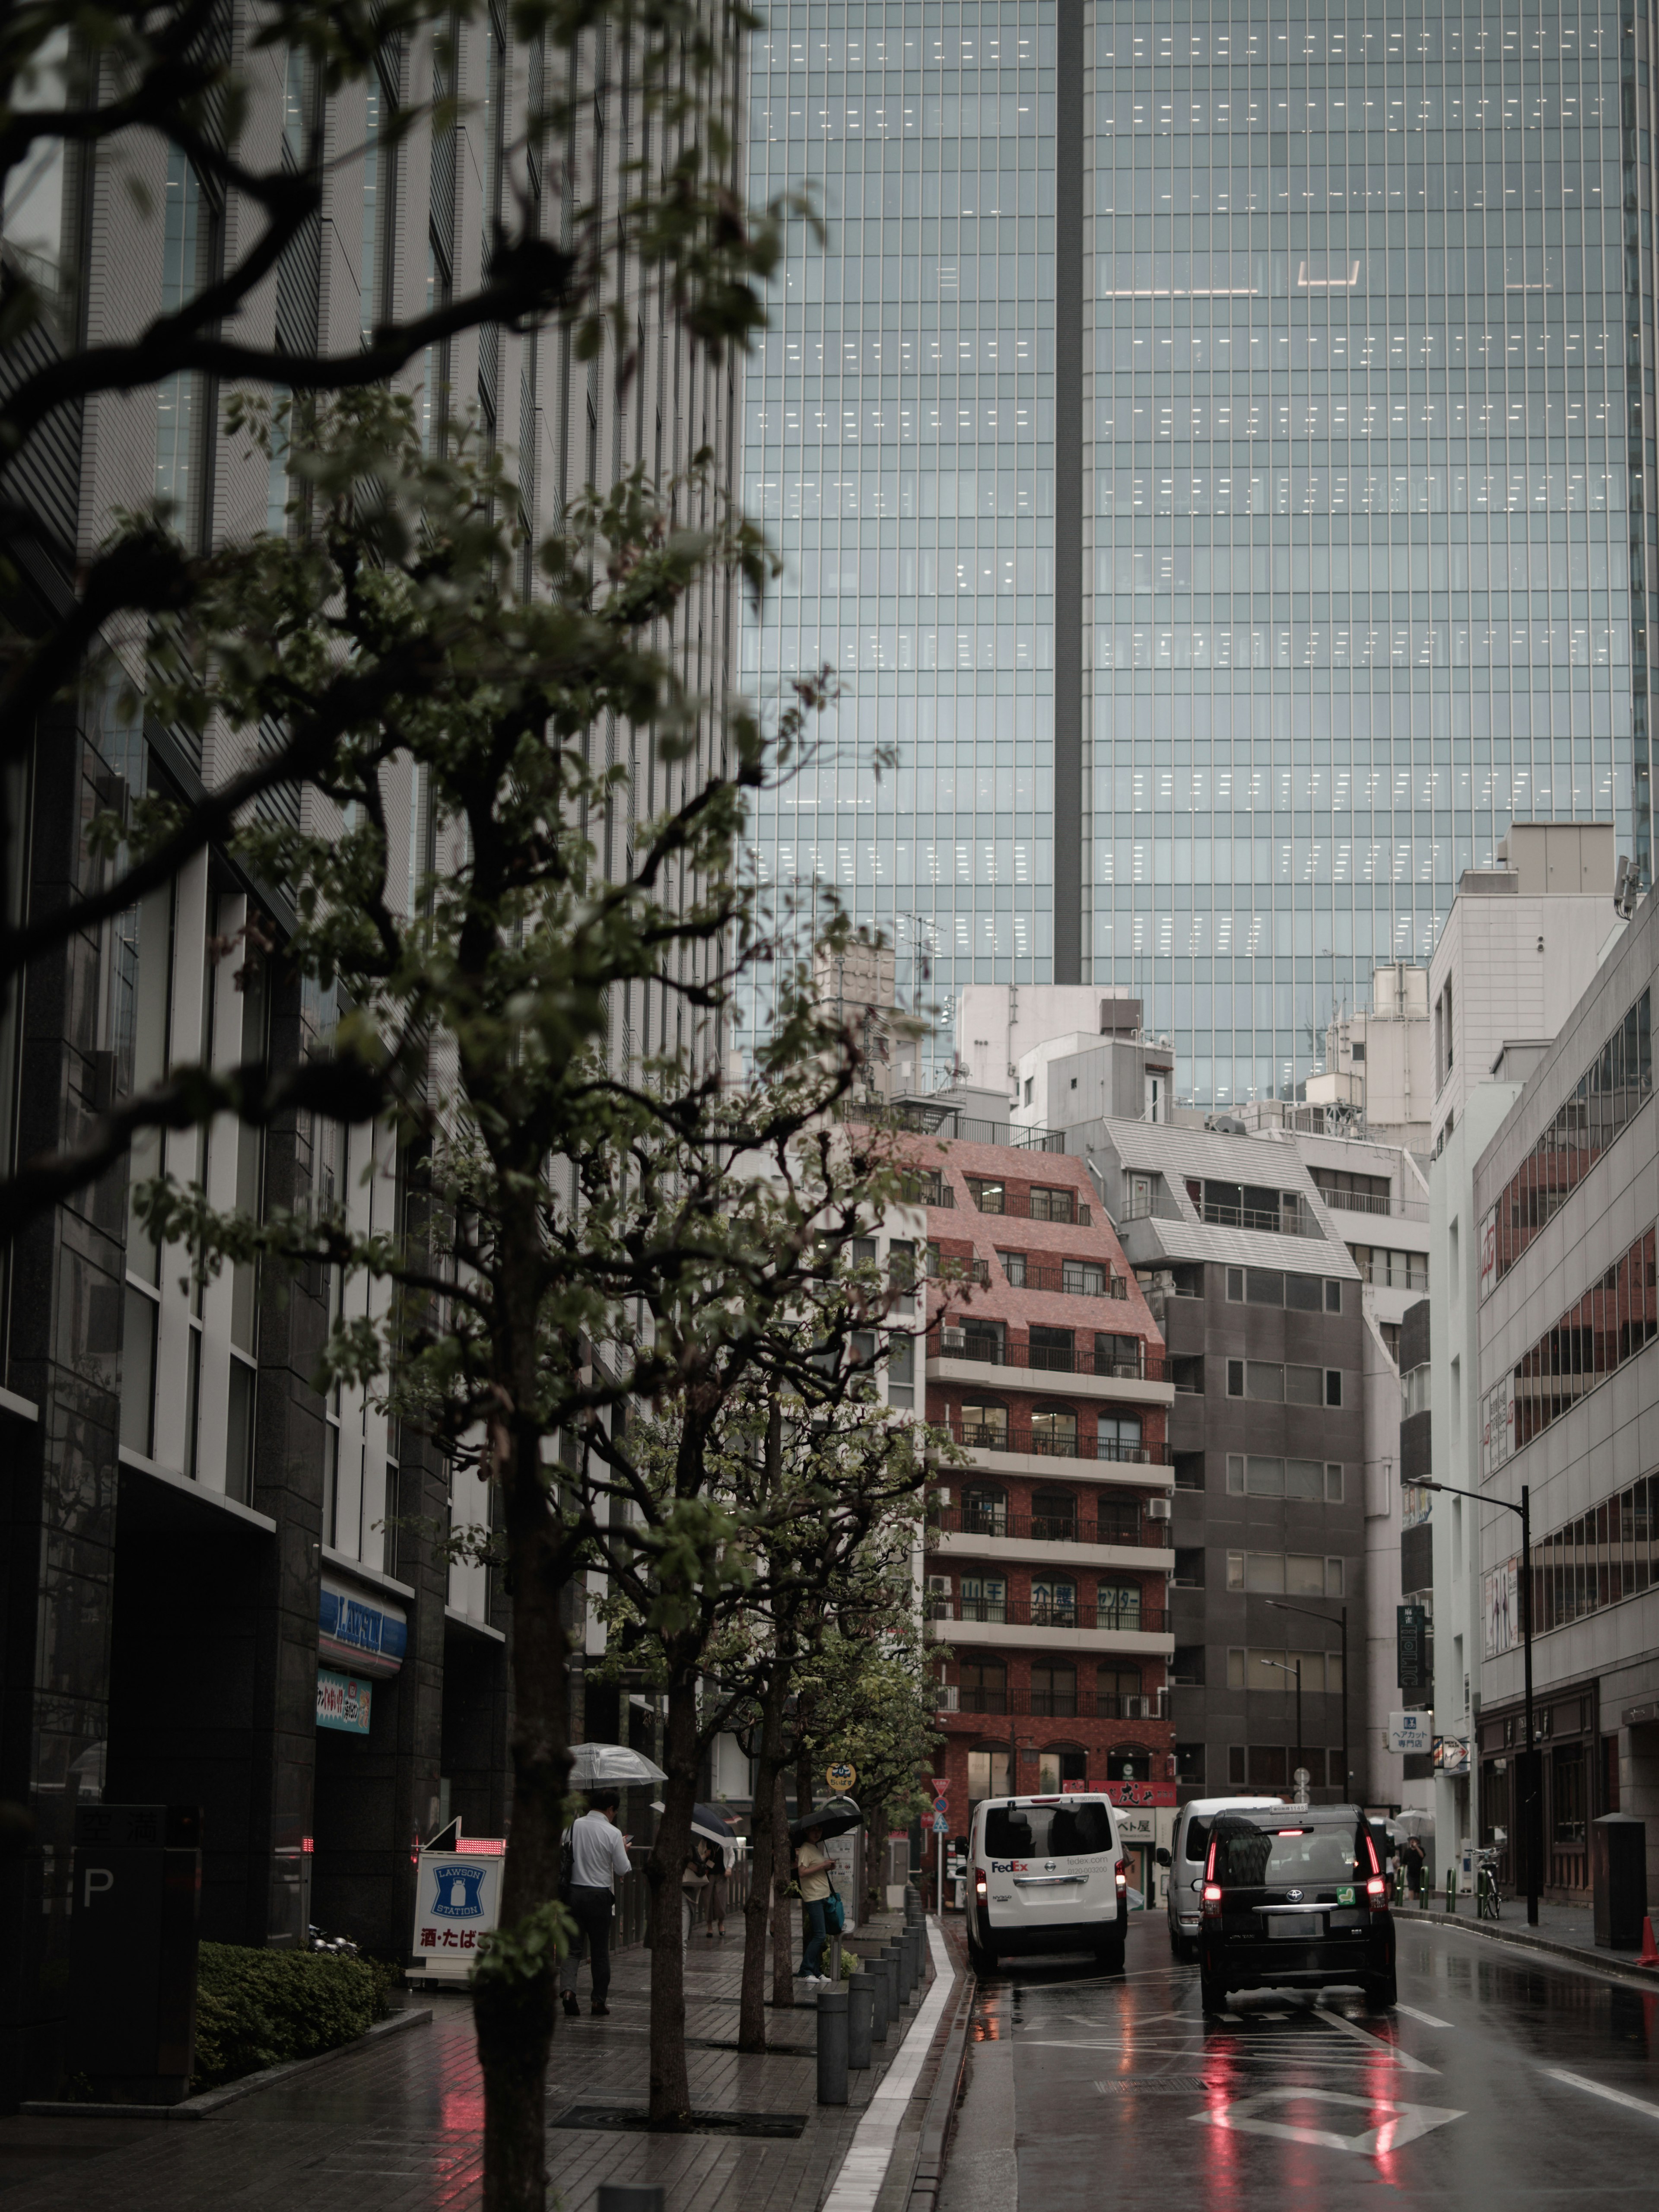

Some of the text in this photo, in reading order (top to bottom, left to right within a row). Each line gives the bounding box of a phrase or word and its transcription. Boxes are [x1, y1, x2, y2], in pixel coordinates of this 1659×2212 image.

[963, 1581, 1138, 1609] 山王介護センター
[337, 1596, 383, 1652] LAWSON
[1405, 1608, 1413, 1624] 麻雀
[1401, 1625, 1418, 1685] HOLIC
[82, 1812, 157, 1843] 空 満
[992, 1860, 1029, 1873] FedEx
[1067, 1857, 1108, 1865] fedex.com
[439, 1868, 481, 1879] LAWSON
[1068, 1866, 1107, 1874] 0120-003200
[84, 1869, 114, 1907] P
[437, 1904, 478, 1915] STATION
